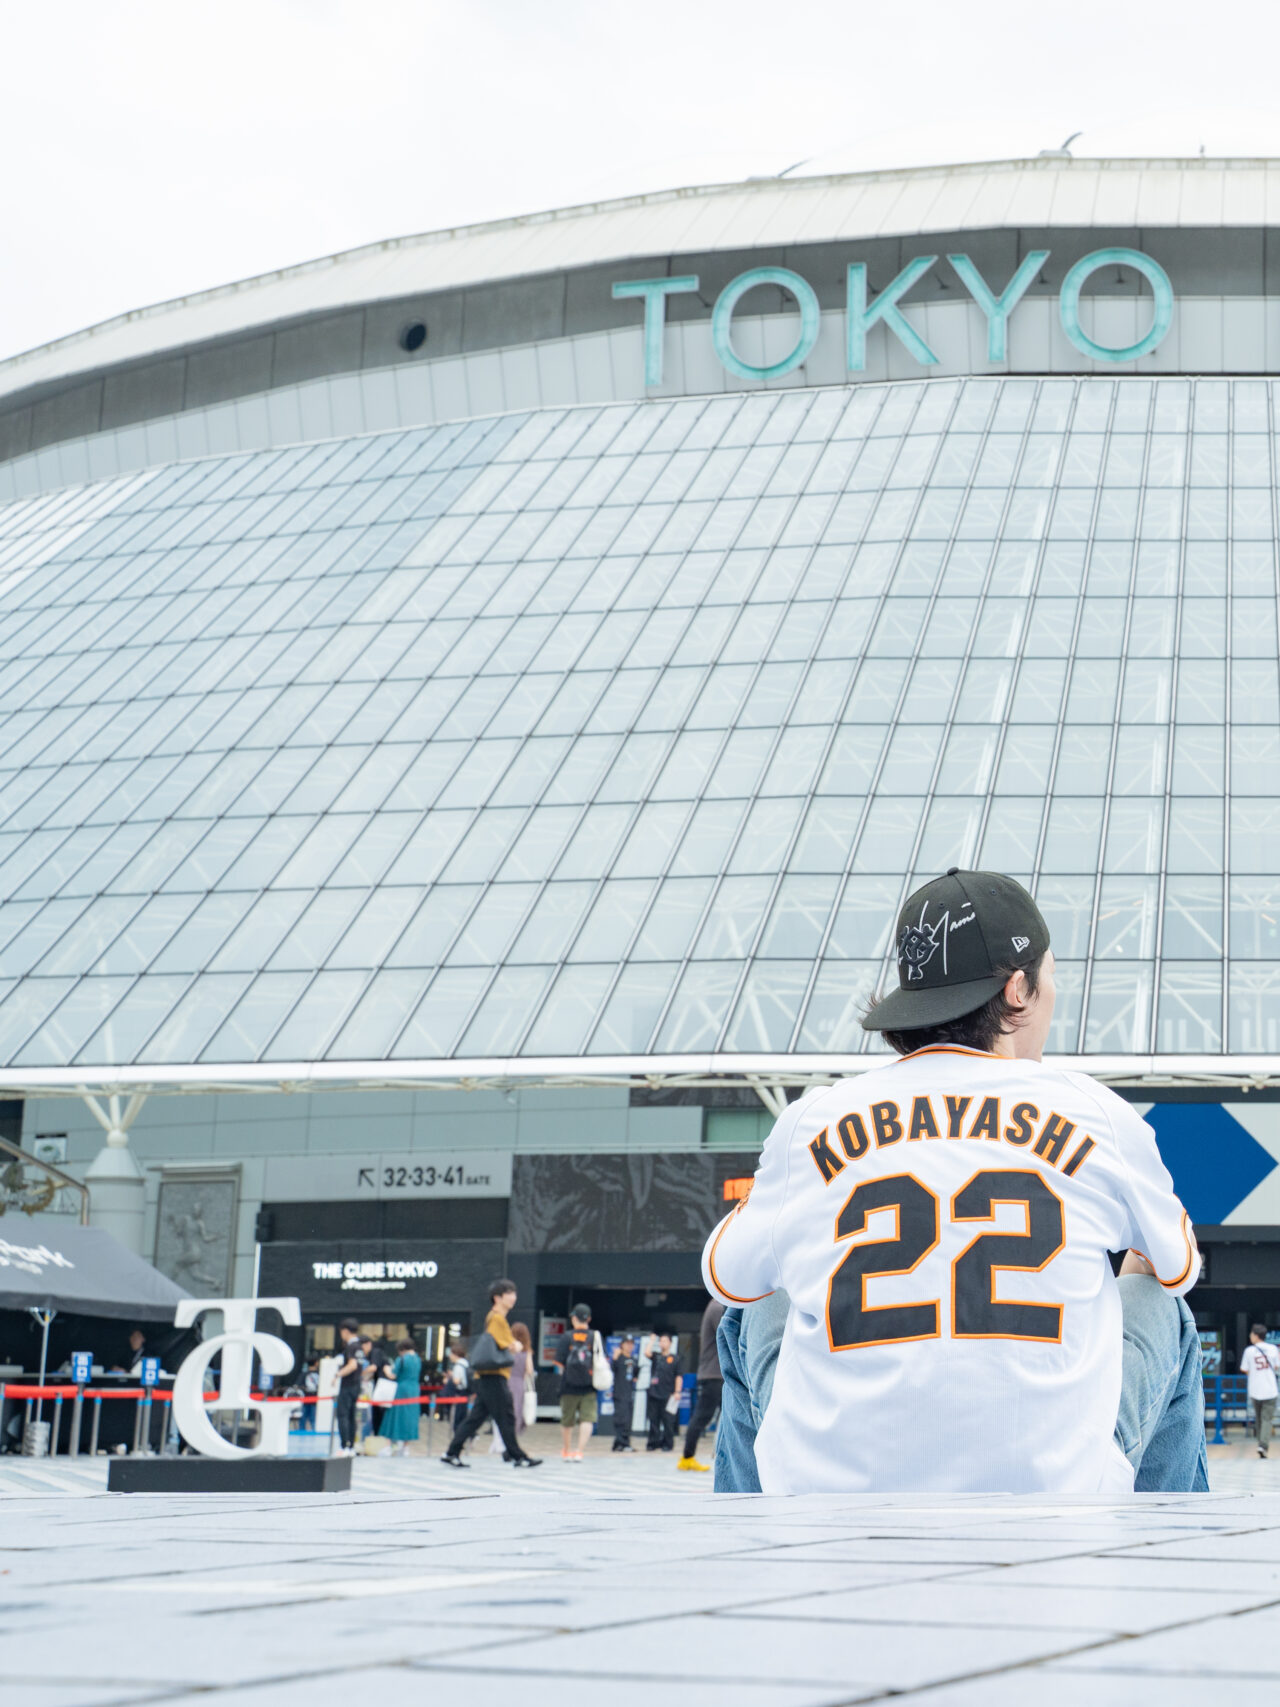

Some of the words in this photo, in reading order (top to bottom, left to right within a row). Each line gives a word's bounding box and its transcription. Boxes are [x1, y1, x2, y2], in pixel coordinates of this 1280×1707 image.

[612, 246, 1174, 387] TOKYO
[808, 1094, 1097, 1186] KOBAYASHI
[312, 1262, 342, 1279] THE
[343, 1262, 385, 1279] CUBE
[386, 1261, 438, 1278] TOKYO
[825, 1168, 1066, 1353] 22
